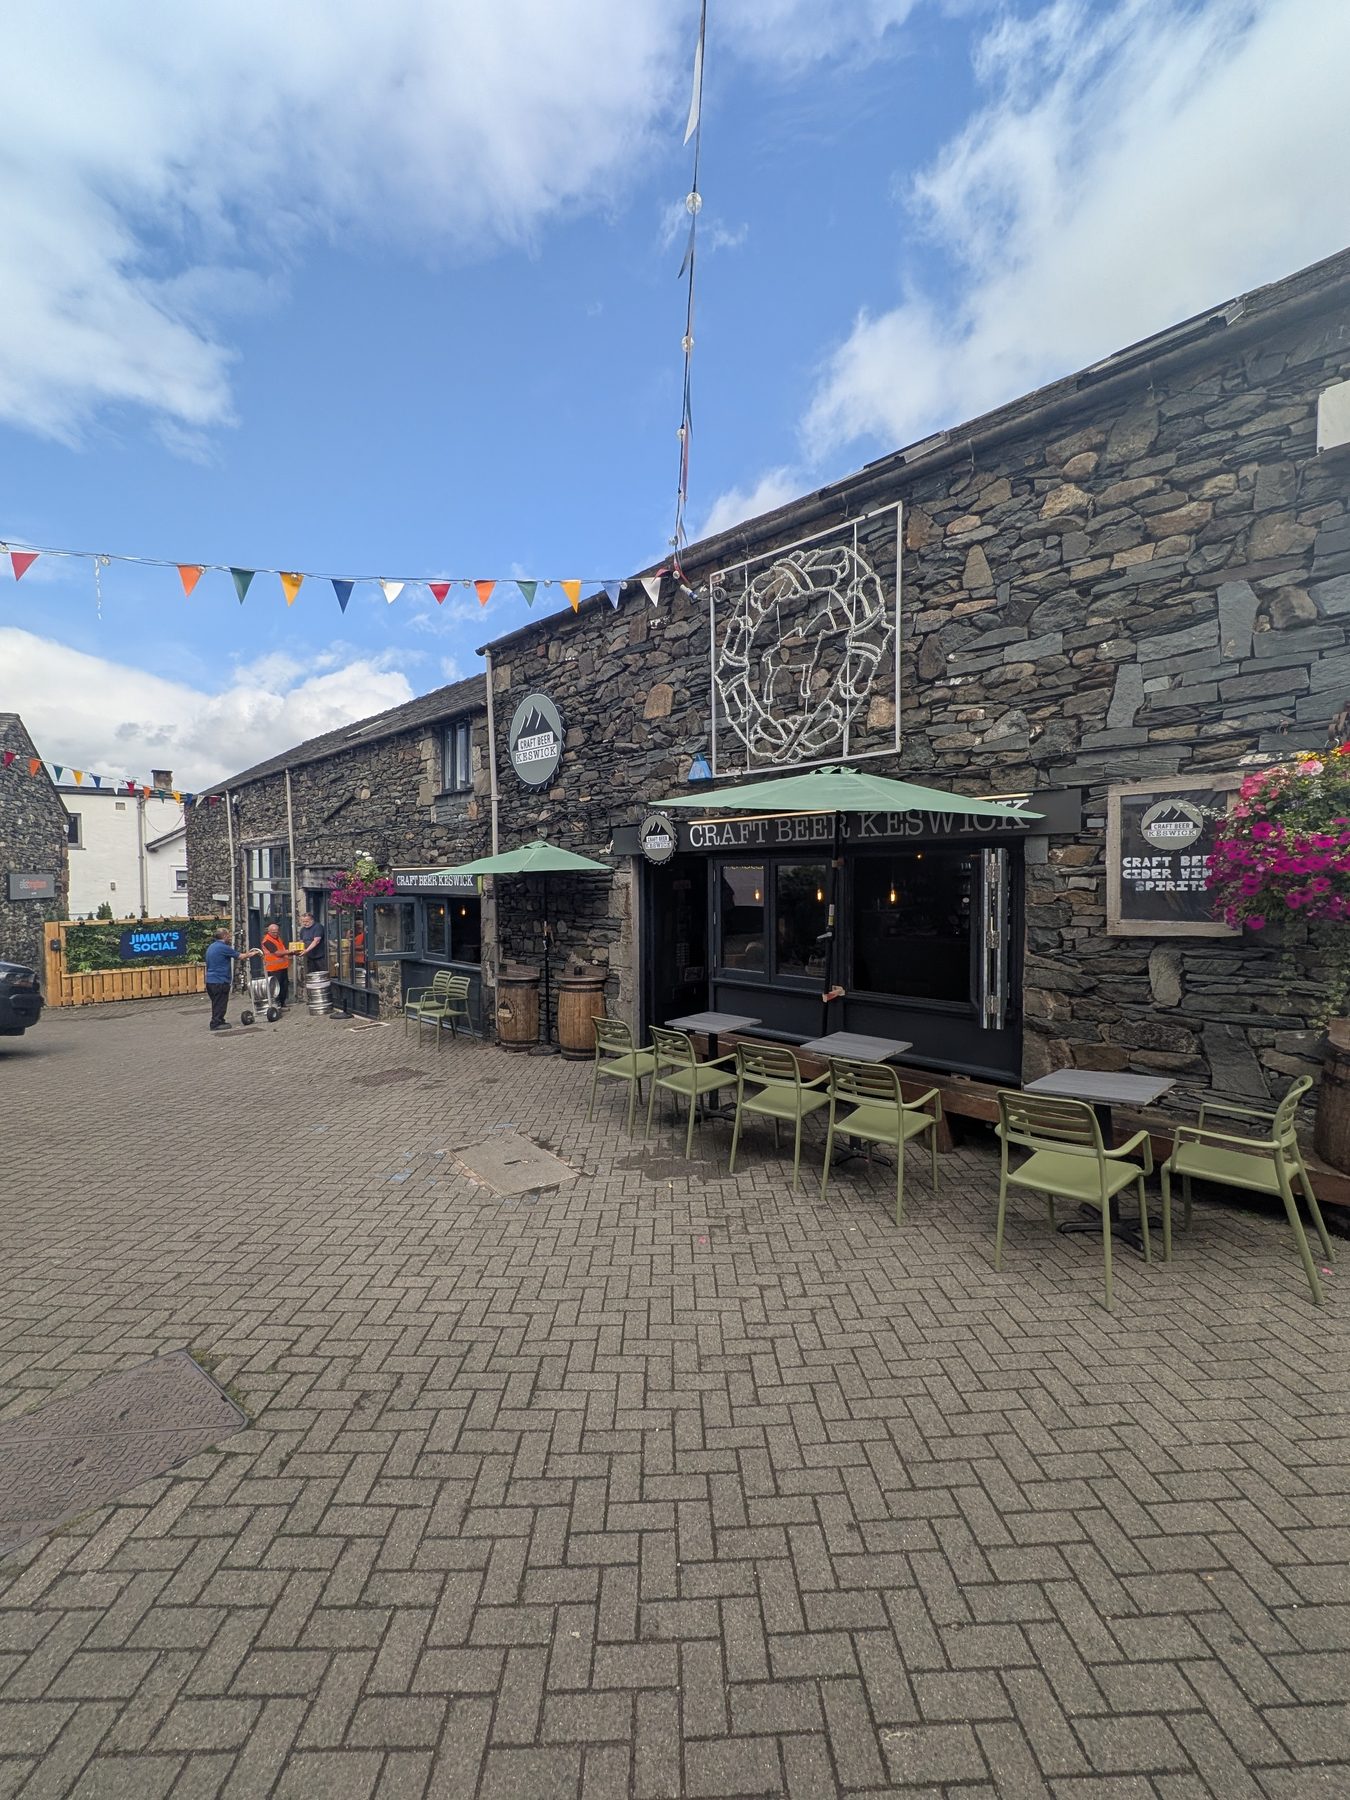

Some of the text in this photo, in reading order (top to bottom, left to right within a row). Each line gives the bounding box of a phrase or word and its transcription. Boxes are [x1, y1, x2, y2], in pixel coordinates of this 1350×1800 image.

[520, 734, 551, 750] CRAFT BEER
[516, 746, 557, 763] KESWICK
[689, 820, 768, 847] CRAFT
[775, 815, 850, 842] BEER
[1122, 856, 1172, 868] CRAFT
[1122, 868, 1172, 879] CIDER
[396, 874, 474, 886] CRAFT BEER KESWICK
[1135, 880, 1208, 891] SPIRITS
[129, 932, 179, 945] JIMMY'S
[133, 941, 177, 952] SOCIAL
